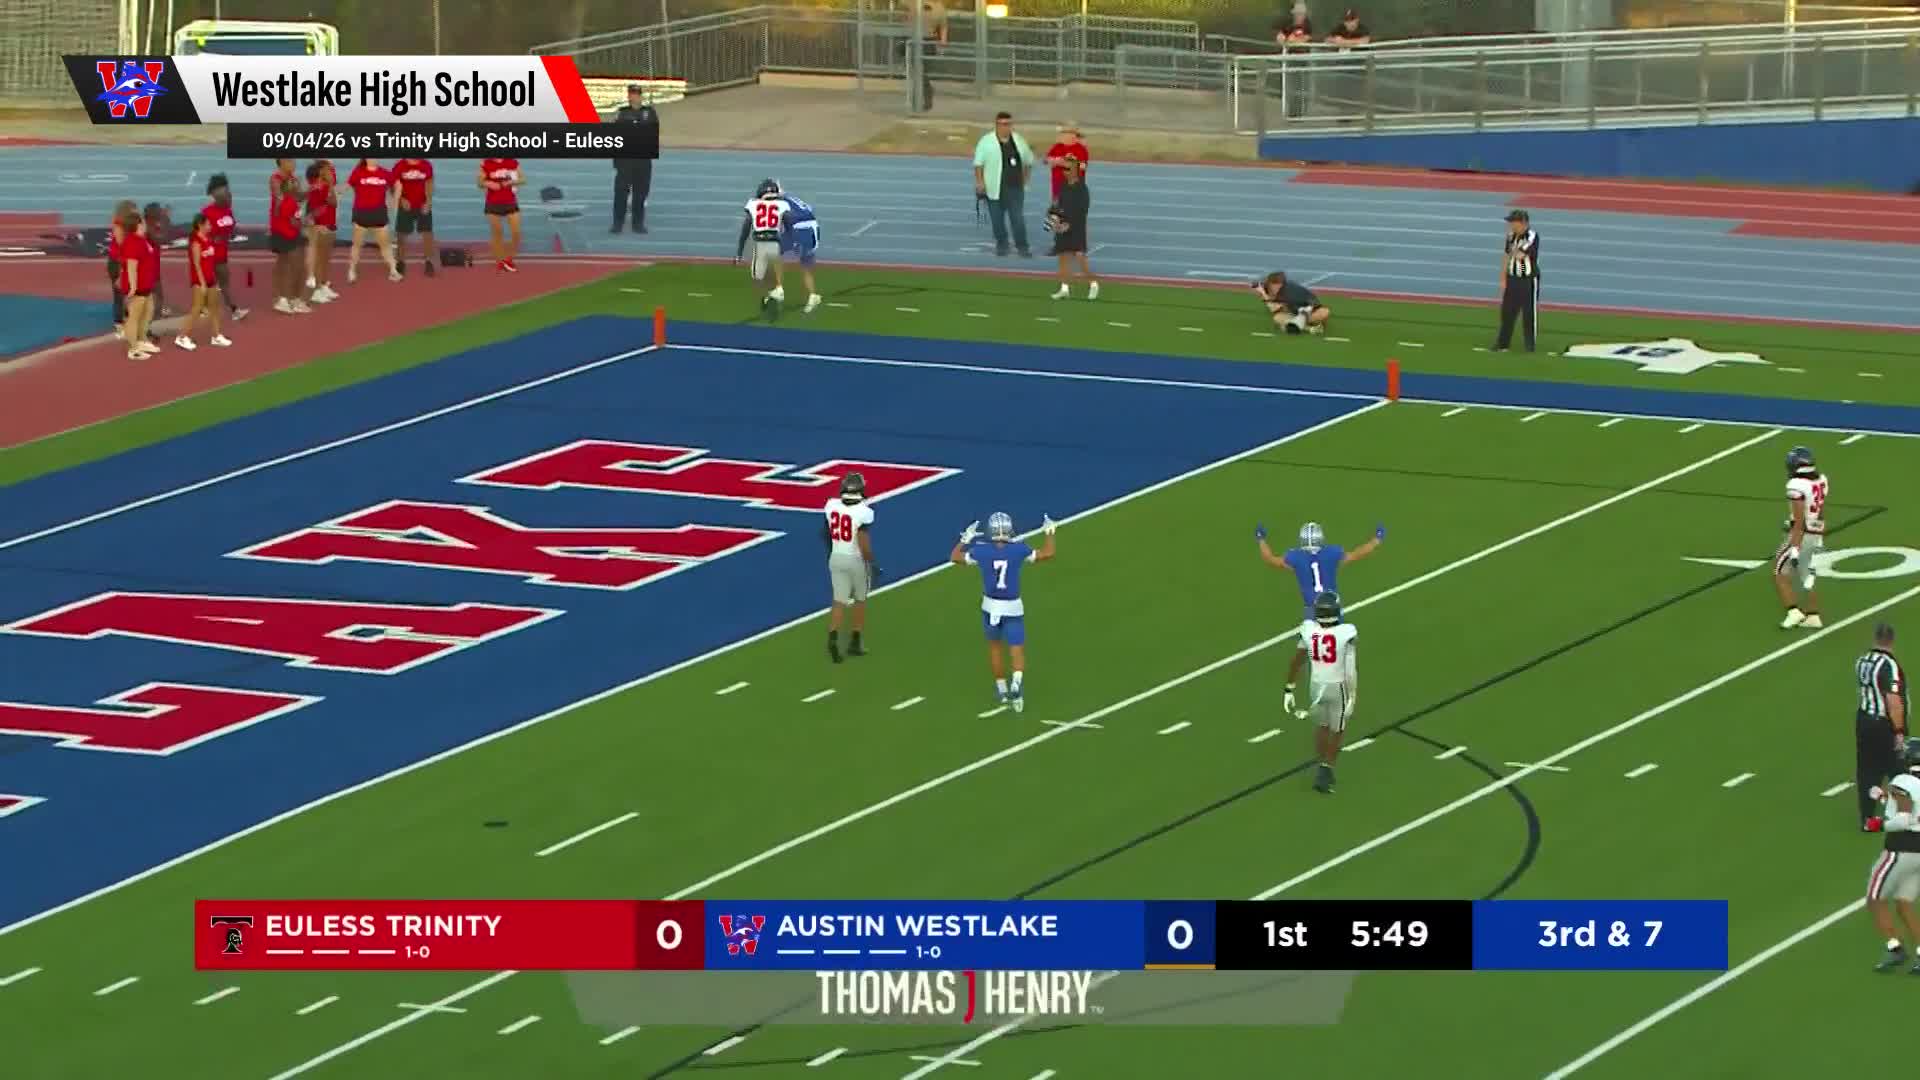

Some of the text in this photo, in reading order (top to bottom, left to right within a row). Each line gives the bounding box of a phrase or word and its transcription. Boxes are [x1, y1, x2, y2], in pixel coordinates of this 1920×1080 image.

[756, 203, 779, 228] 26
[829, 511, 853, 542] 28
[993, 559, 1008, 589] 7
[1310, 561, 1324, 593] 1
[0, 440, 963, 817] LAKE
[1311, 632, 1337, 664] 13
